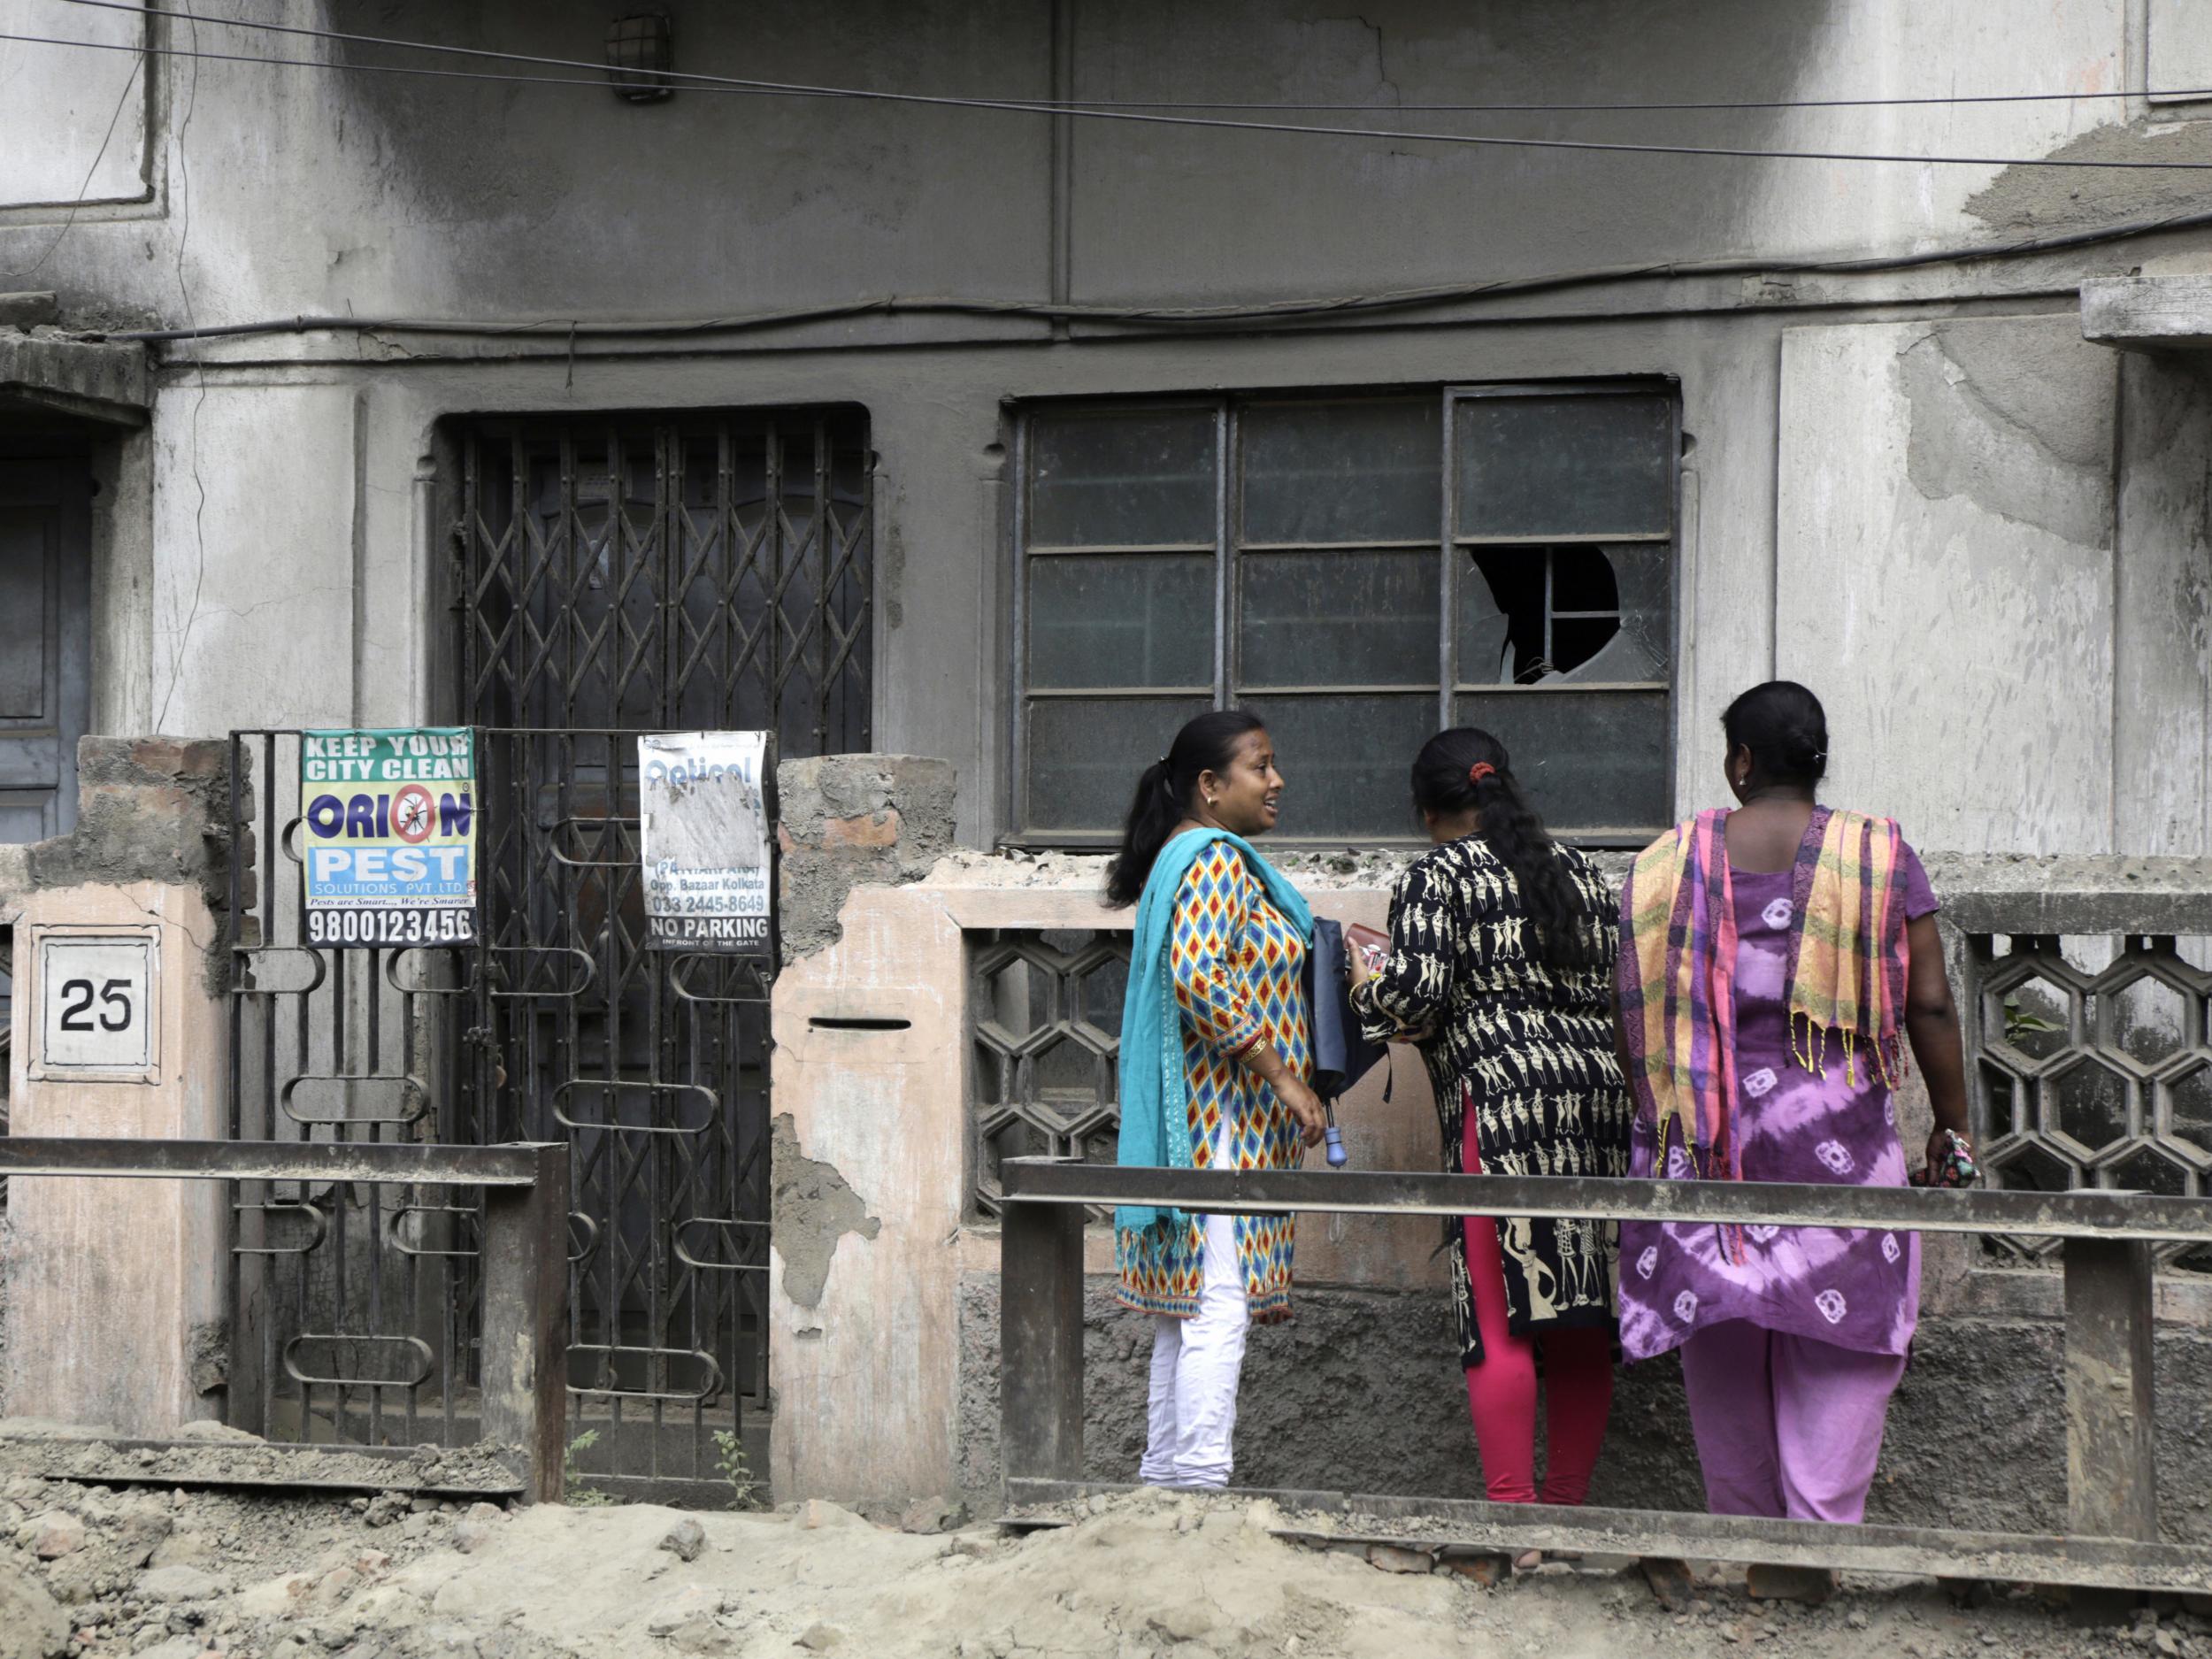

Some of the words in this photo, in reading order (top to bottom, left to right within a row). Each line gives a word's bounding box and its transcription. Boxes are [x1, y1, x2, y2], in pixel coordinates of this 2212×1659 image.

[306, 735, 377, 757] KEEP
[388, 734, 468, 757] YOUR
[306, 759, 375, 780] CITY
[381, 758, 469, 780] CLEAN
[307, 784, 472, 844] ORION
[315, 847, 465, 882] PEST
[315, 883, 397, 895] SOLUTIONS
[680, 879, 719, 891] Bazaar
[722, 877, 764, 891] Kolkata
[401, 897, 431, 906] We're
[653, 895, 681, 912] 033
[686, 895, 764, 912] 2445-8649
[309, 910, 472, 942] 9800123456
[650, 918, 679, 937] NO
[684, 918, 769, 939] PARKING
[662, 938, 700, 947] INFRONT
[60, 979, 132, 1033] 25
